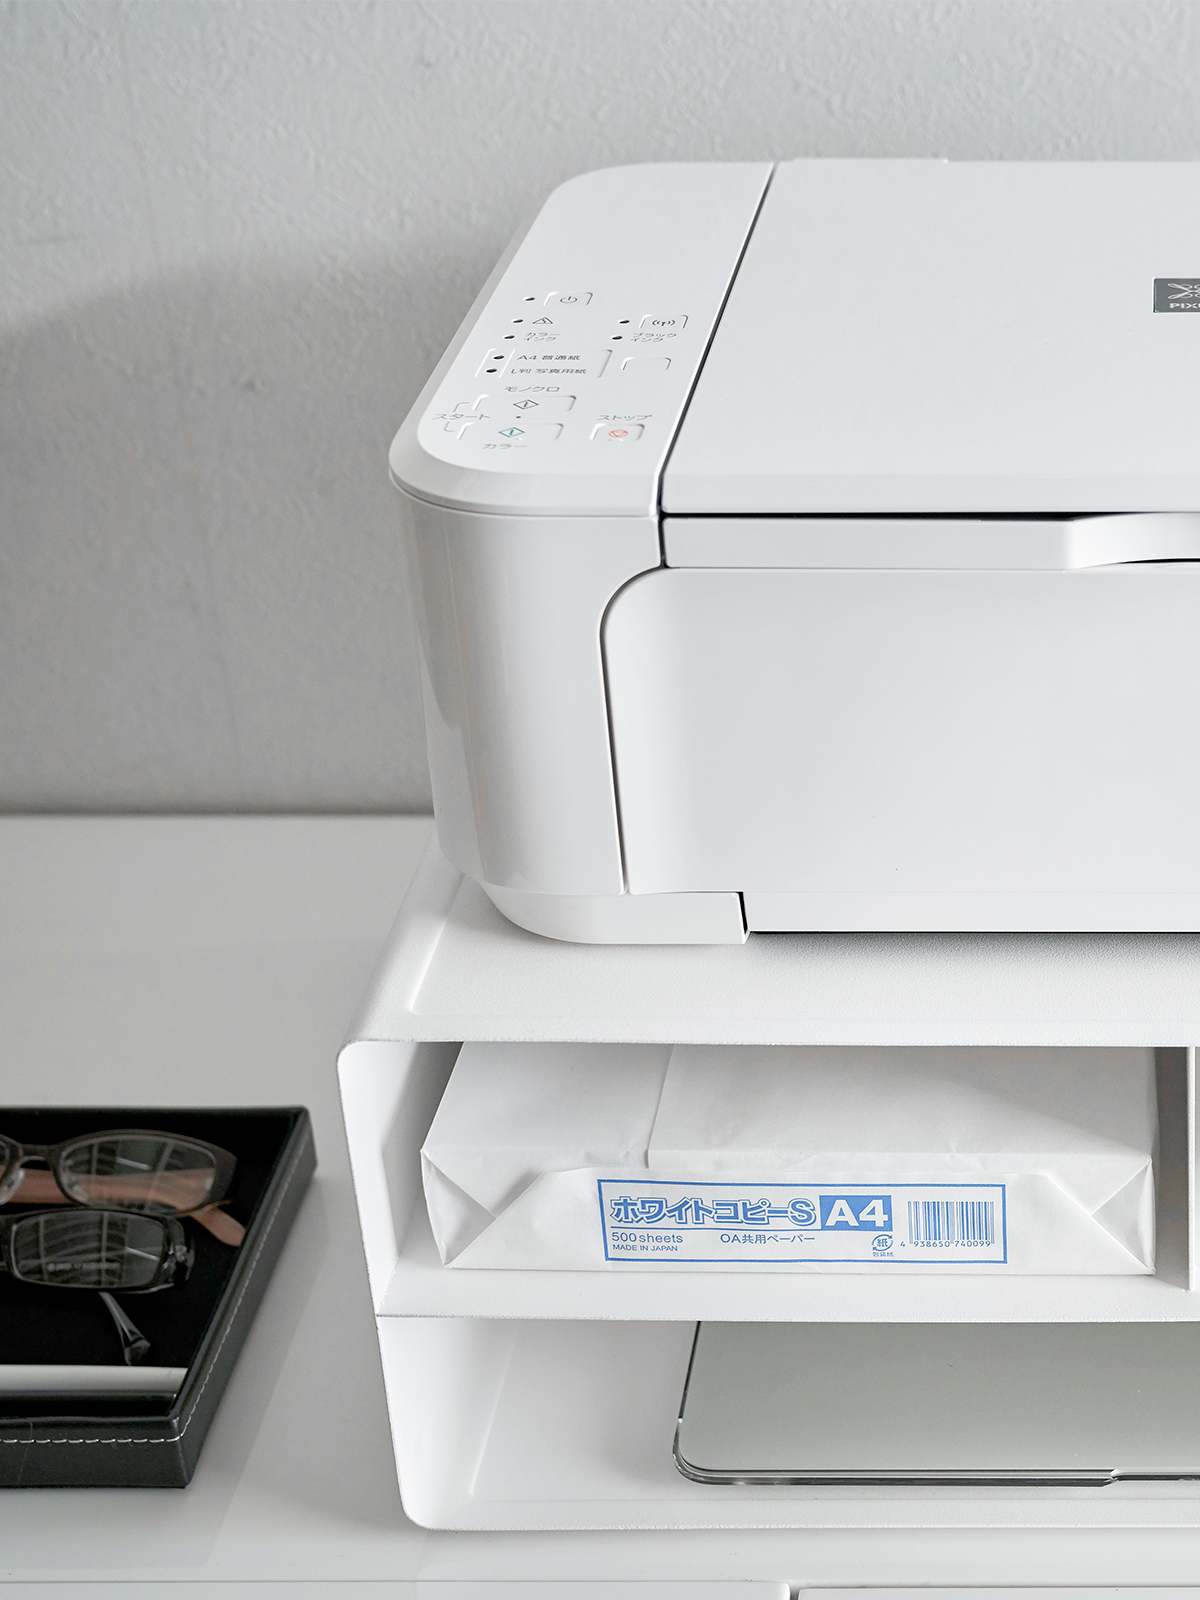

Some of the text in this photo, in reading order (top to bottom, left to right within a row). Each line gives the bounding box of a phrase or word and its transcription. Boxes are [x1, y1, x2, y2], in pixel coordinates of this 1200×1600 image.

[597, 413, 654, 421] ストップ
[610, 1196, 889, 1227] ホワイトコピーS A4
[611, 1232, 684, 1243] 500 sheets
[720, 1233, 816, 1244] OA共用ペーパー
[877, 1238, 888, 1248] 紙
[913, 1240, 951, 1248] 938650
[954, 1240, 991, 1248] 740099
